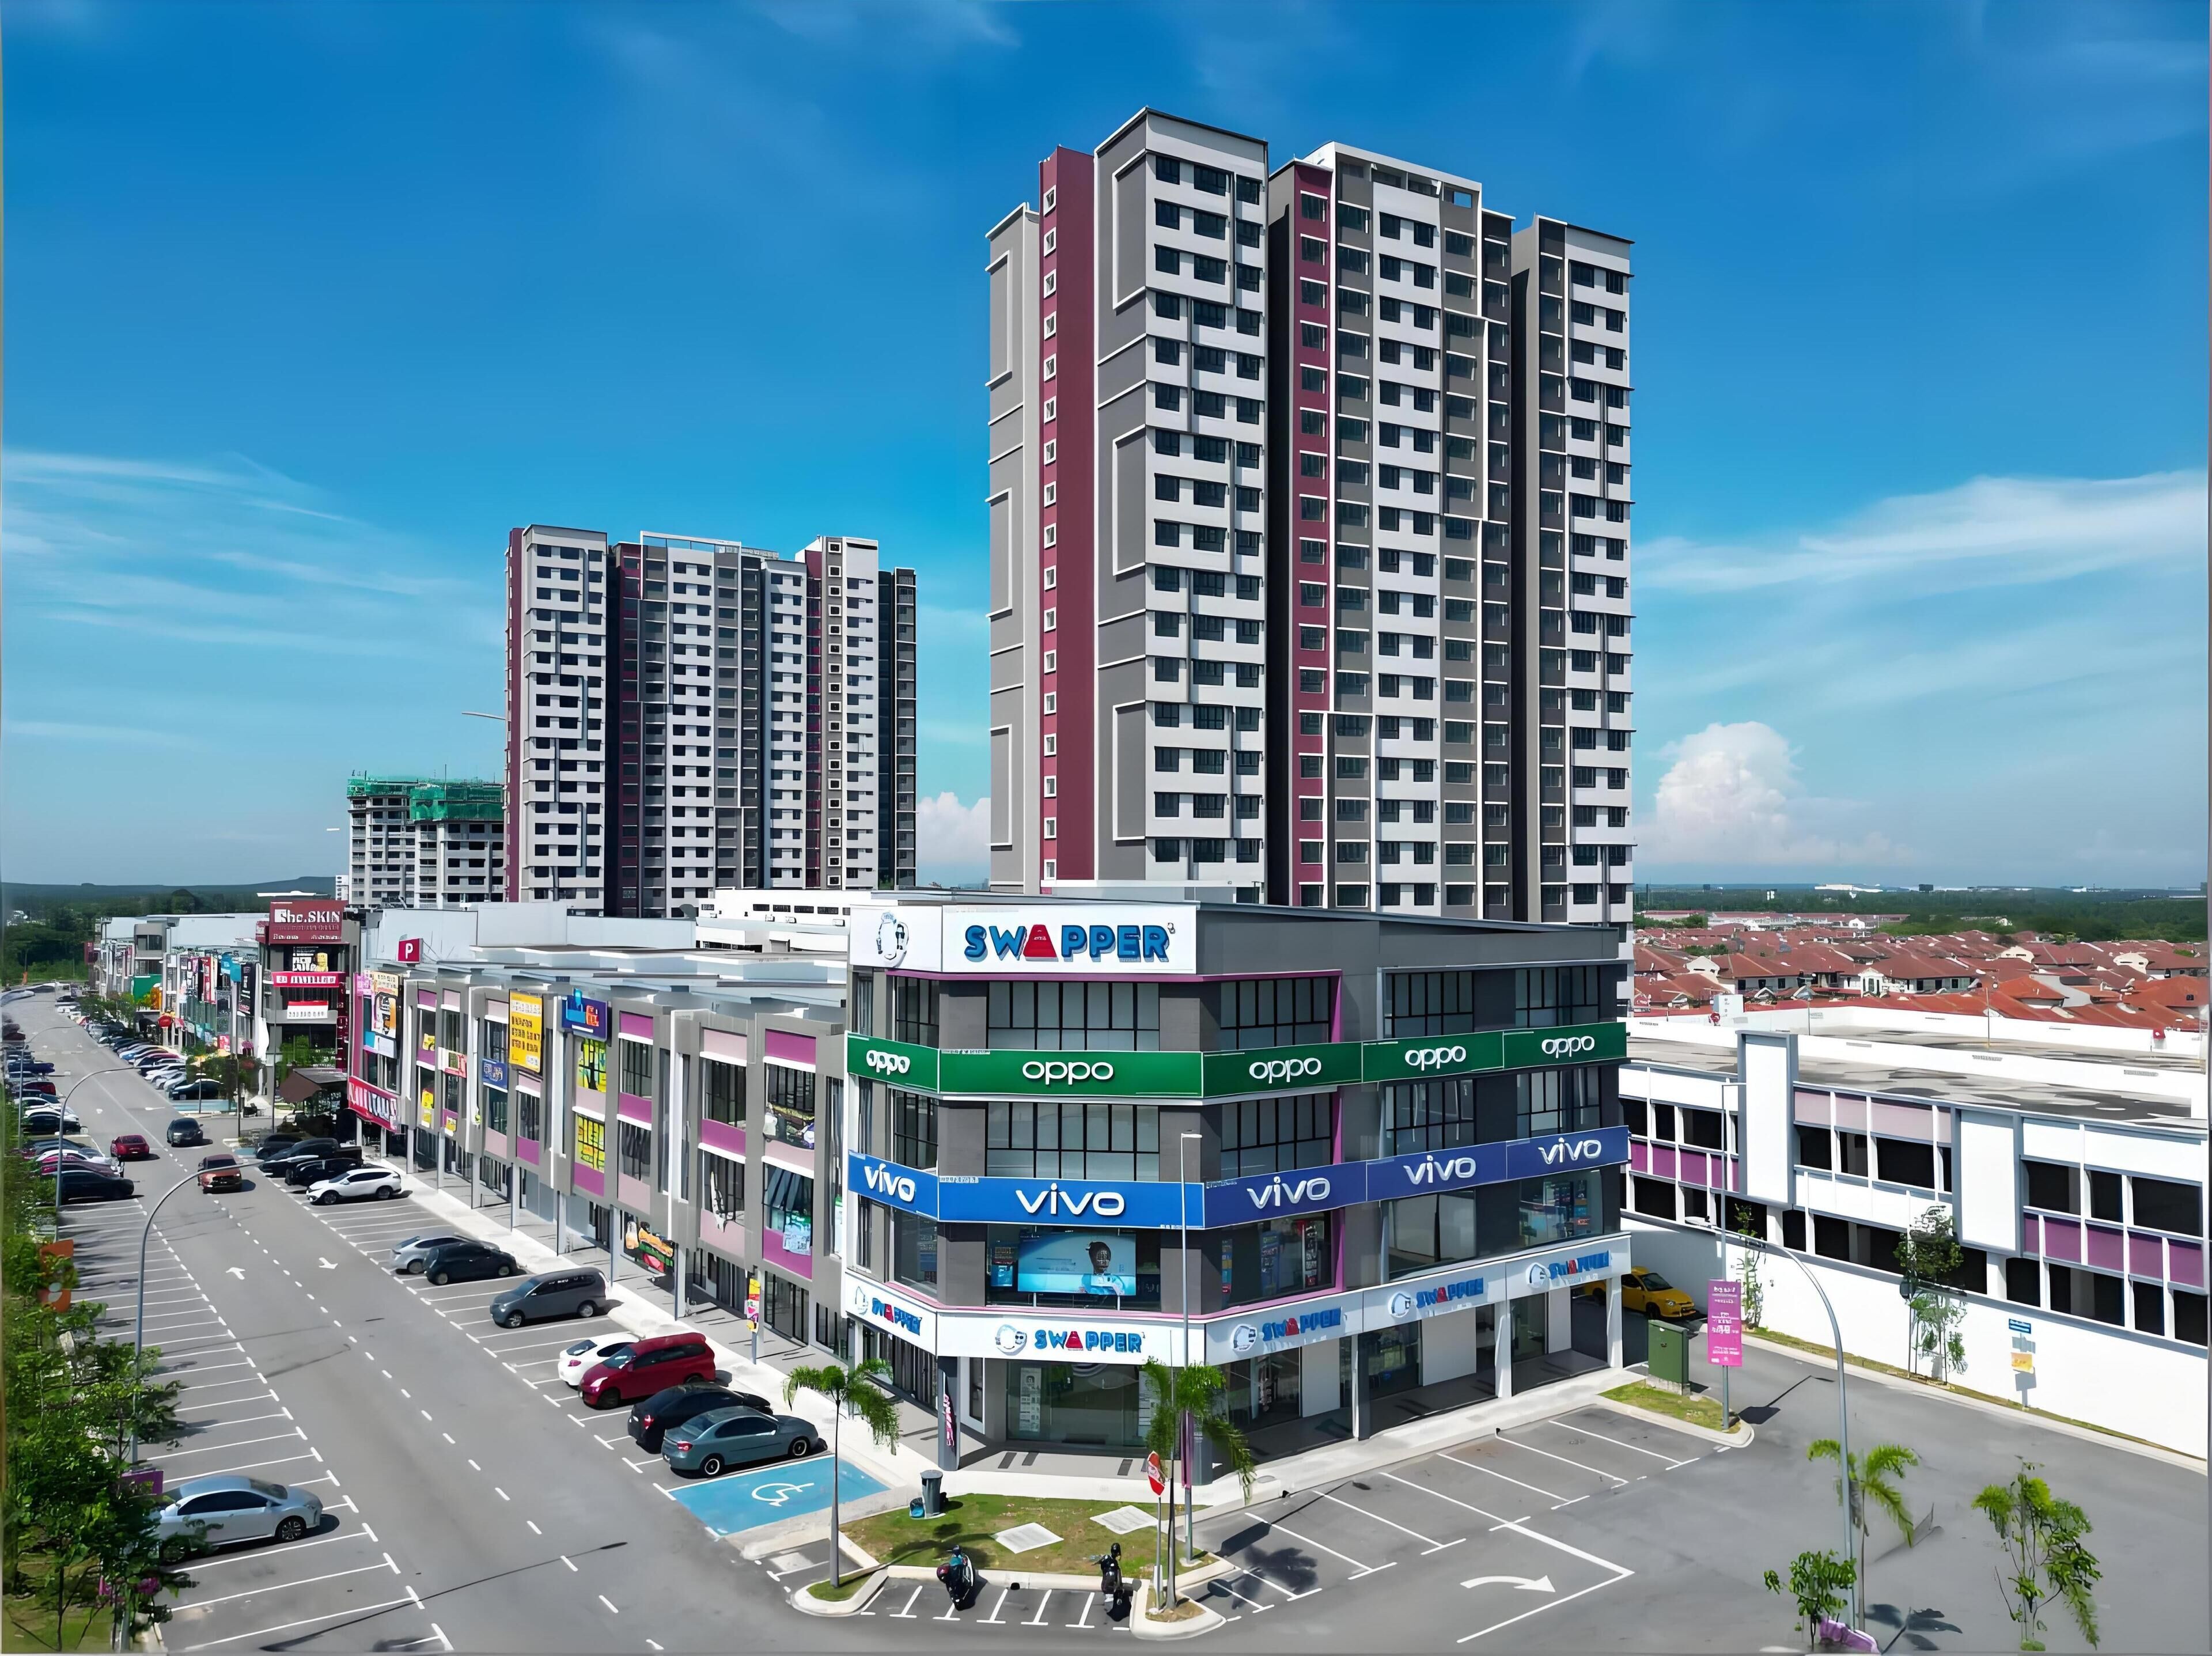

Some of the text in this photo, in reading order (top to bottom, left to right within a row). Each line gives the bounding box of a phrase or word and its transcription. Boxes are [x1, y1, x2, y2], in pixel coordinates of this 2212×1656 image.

[405, 942, 414, 959] P
[964, 924, 1170, 962] SWAPPER
[1404, 1045, 1467, 1071] oppo
[1541, 1036, 1595, 1059] oppo
[866, 1049, 910, 1075] oppo
[1022, 1061, 1113, 1085] oppo
[1249, 1058, 1321, 1084] oppo
[1537, 1137, 1601, 1165] vivo
[864, 1163, 916, 1202] vivo
[1403, 1155, 1476, 1185] vivo
[1015, 1183, 1124, 1216] vivo
[1247, 1176, 1331, 1209] vivo
[1034, 1329, 1142, 1353] SWAPPER
